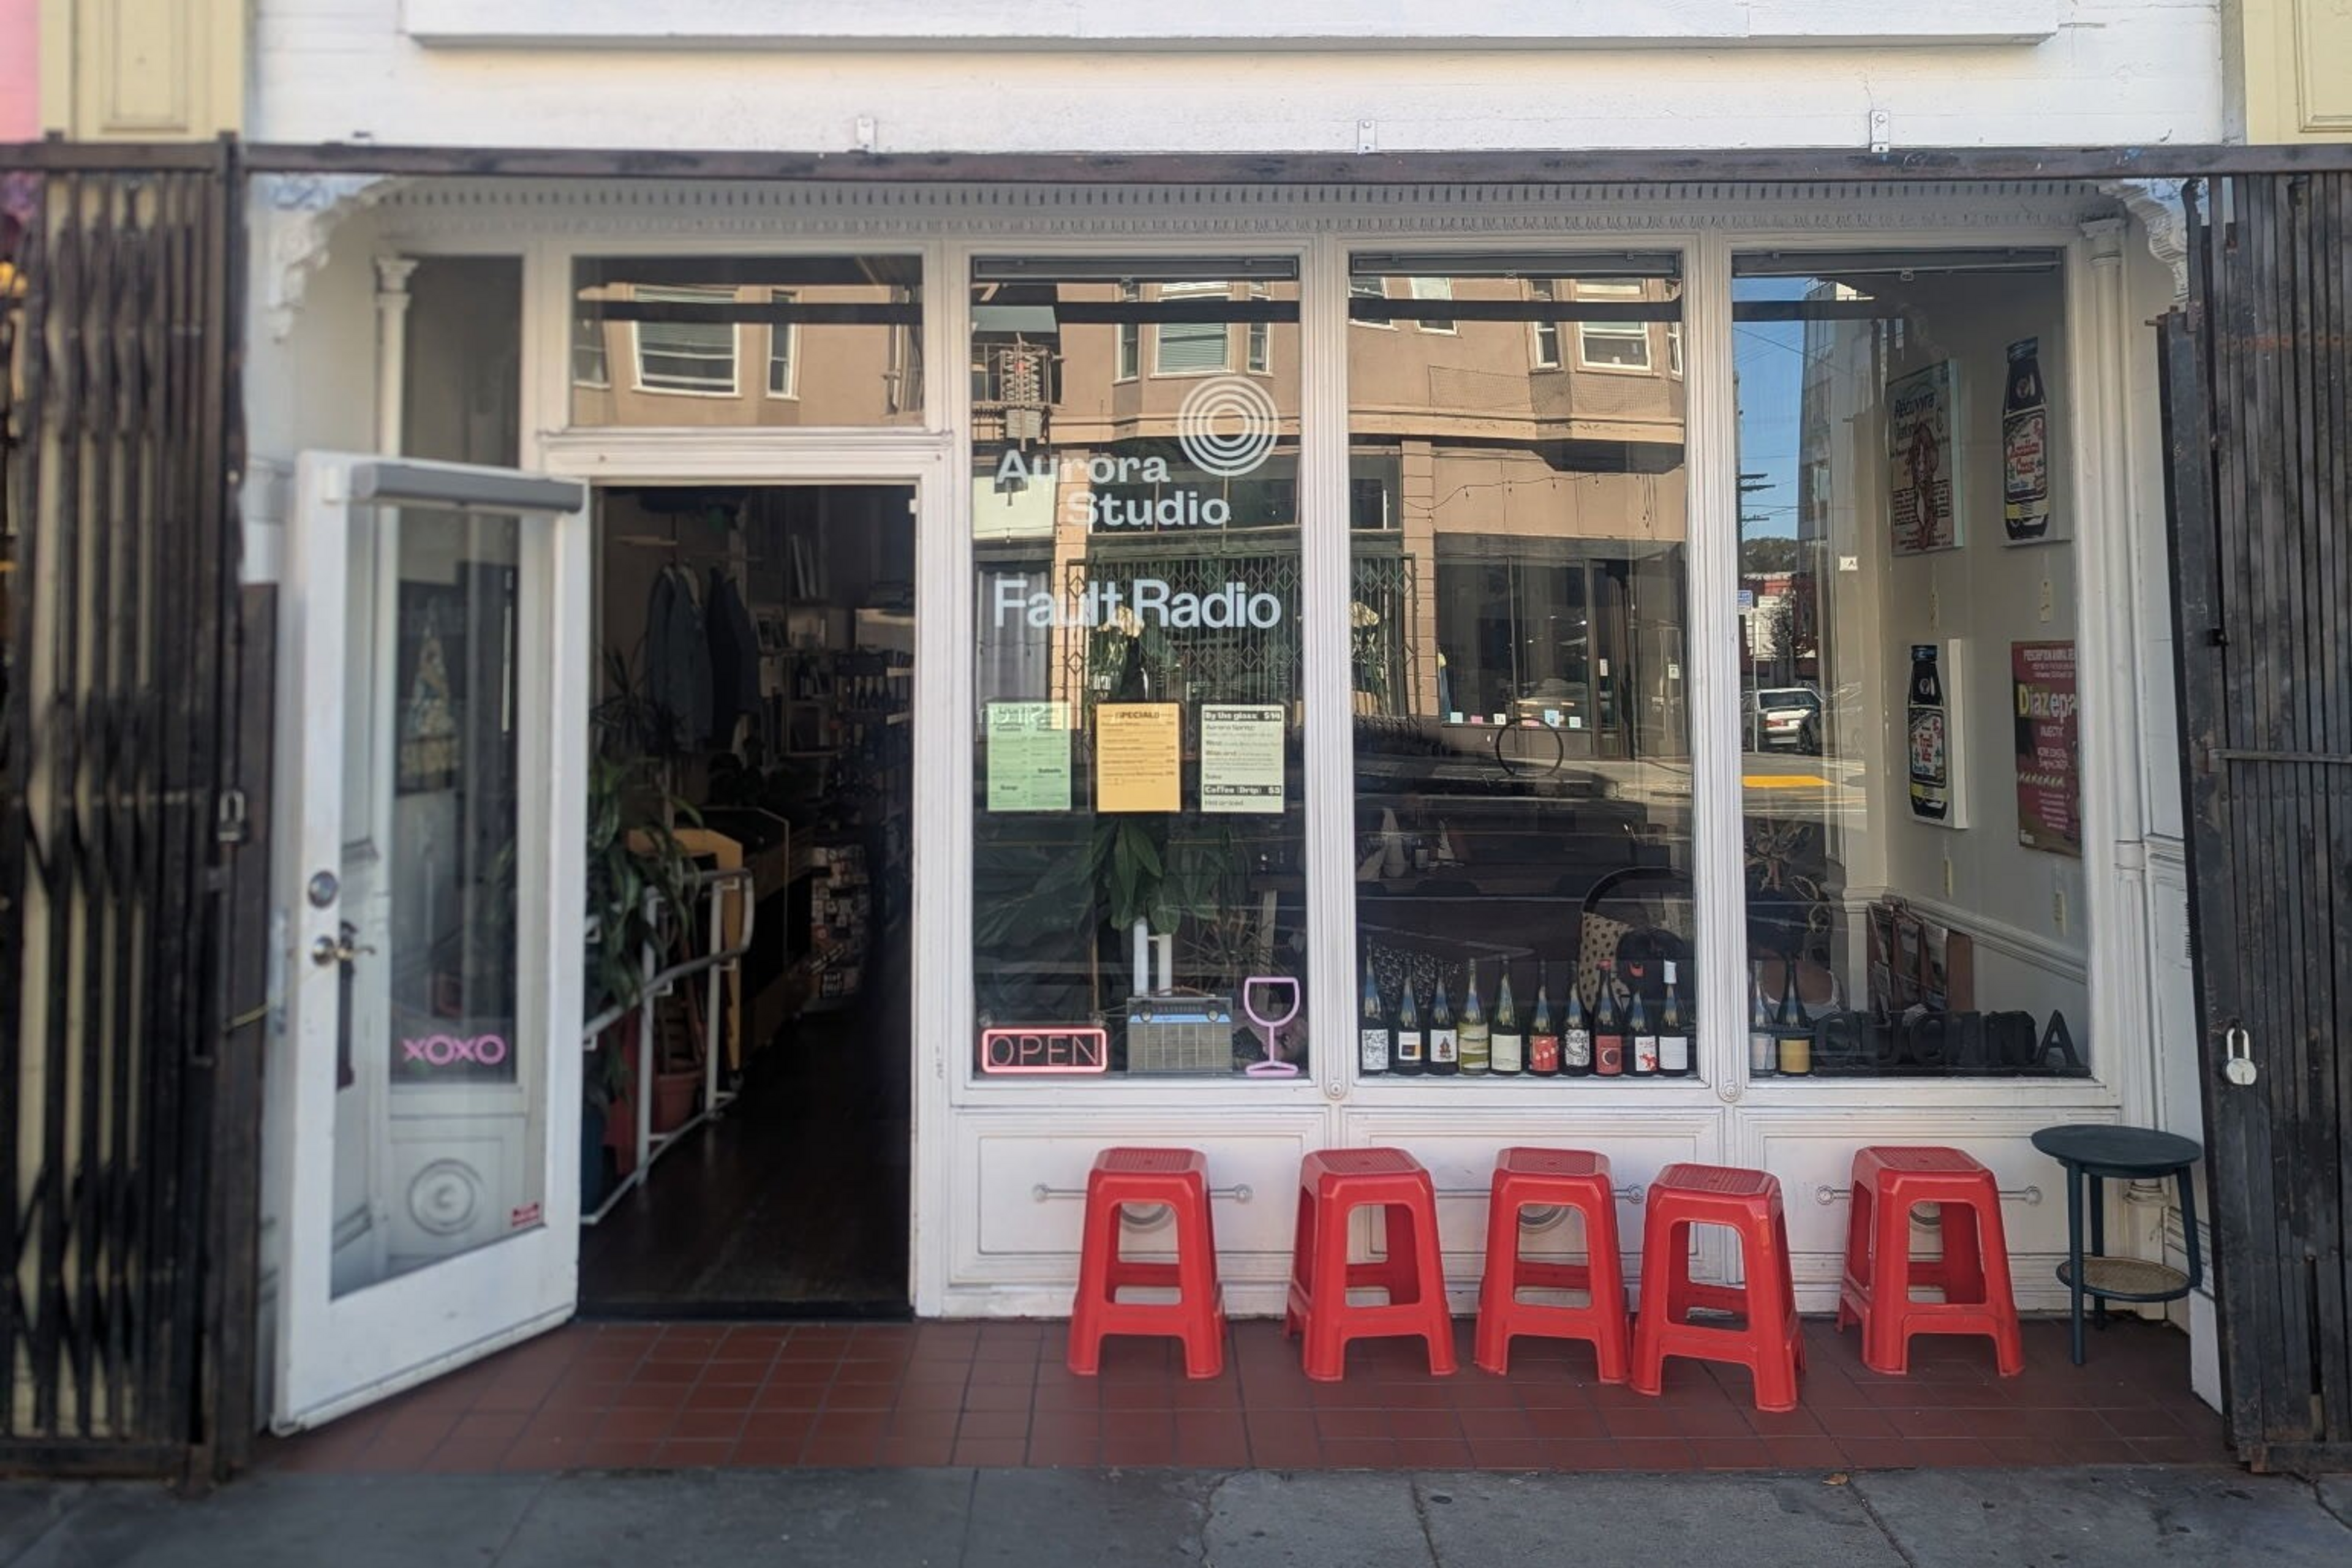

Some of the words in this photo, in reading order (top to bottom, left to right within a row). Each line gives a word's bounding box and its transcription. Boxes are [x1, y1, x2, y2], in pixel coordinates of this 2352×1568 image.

[996, 449, 1171, 484] Aurora
[1066, 490, 1232, 526] Studio
[994, 578, 1124, 628] Fault
[1133, 578, 1282, 629] Radio
[1205, 712, 1216, 720] By
[402, 1034, 506, 1066] XOXO
[989, 1034, 1099, 1066] OPEN
